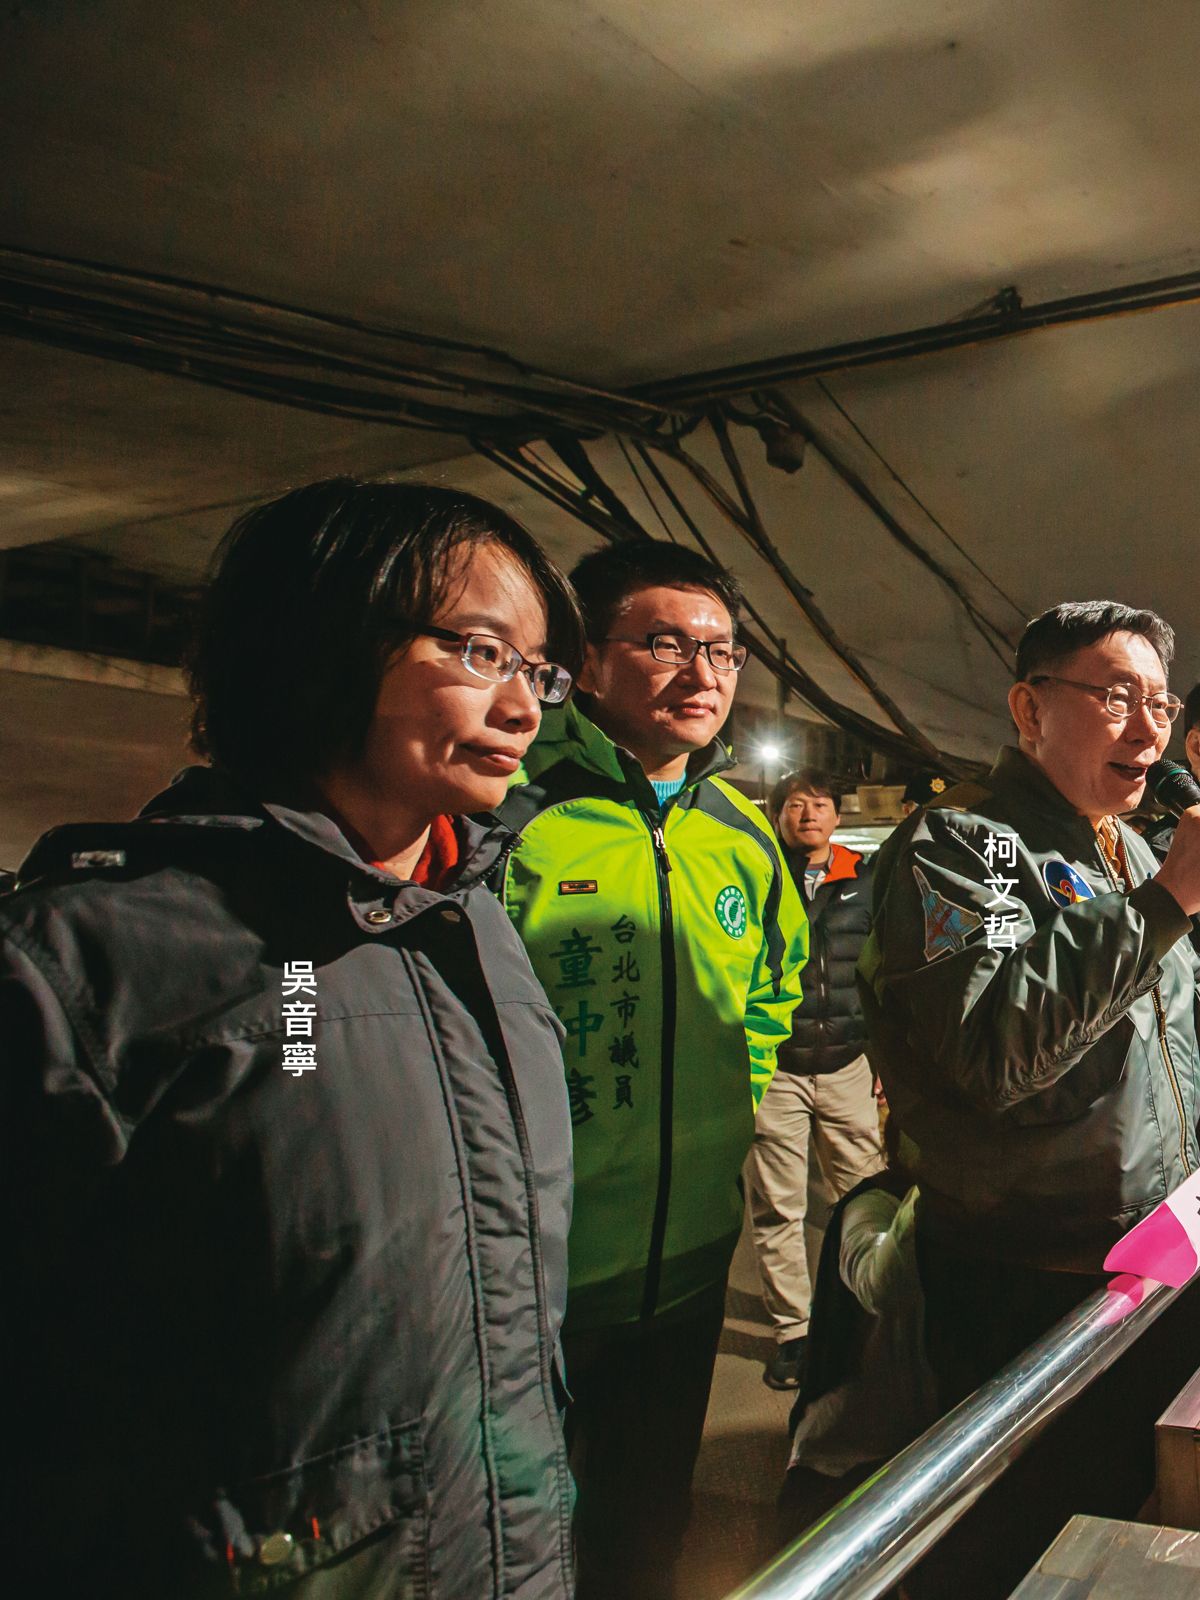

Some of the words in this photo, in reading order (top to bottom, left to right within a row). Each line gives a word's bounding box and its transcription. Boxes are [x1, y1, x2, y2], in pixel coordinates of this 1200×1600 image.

[608, 914, 640, 1110] 台北市議員
